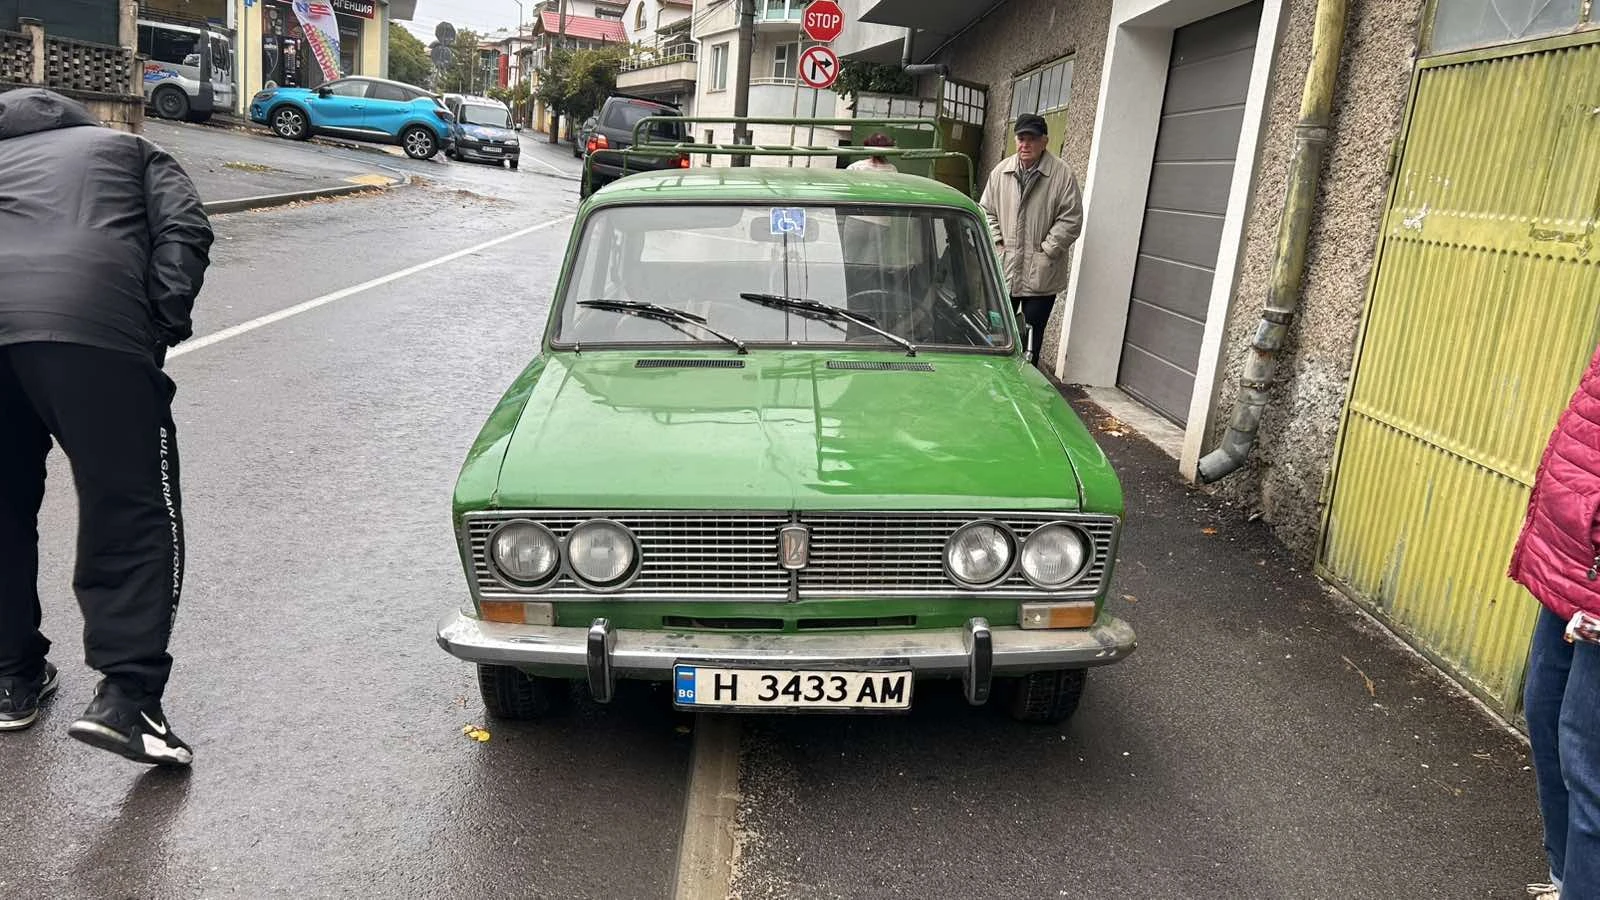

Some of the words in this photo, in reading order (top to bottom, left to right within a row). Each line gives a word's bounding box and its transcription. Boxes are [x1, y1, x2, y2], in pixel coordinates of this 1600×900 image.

[333, 0, 373, 14] АГЕНЦИЯ
[807, 12, 840, 29] STOP
[159, 426, 176, 519] BULGARIAN
[170, 521, 180, 599] NATIONAL
[678, 689, 694, 698] BG
[713, 673, 738, 701] H
[757, 674, 848, 702] 3433
[856, 676, 905, 703] AM
